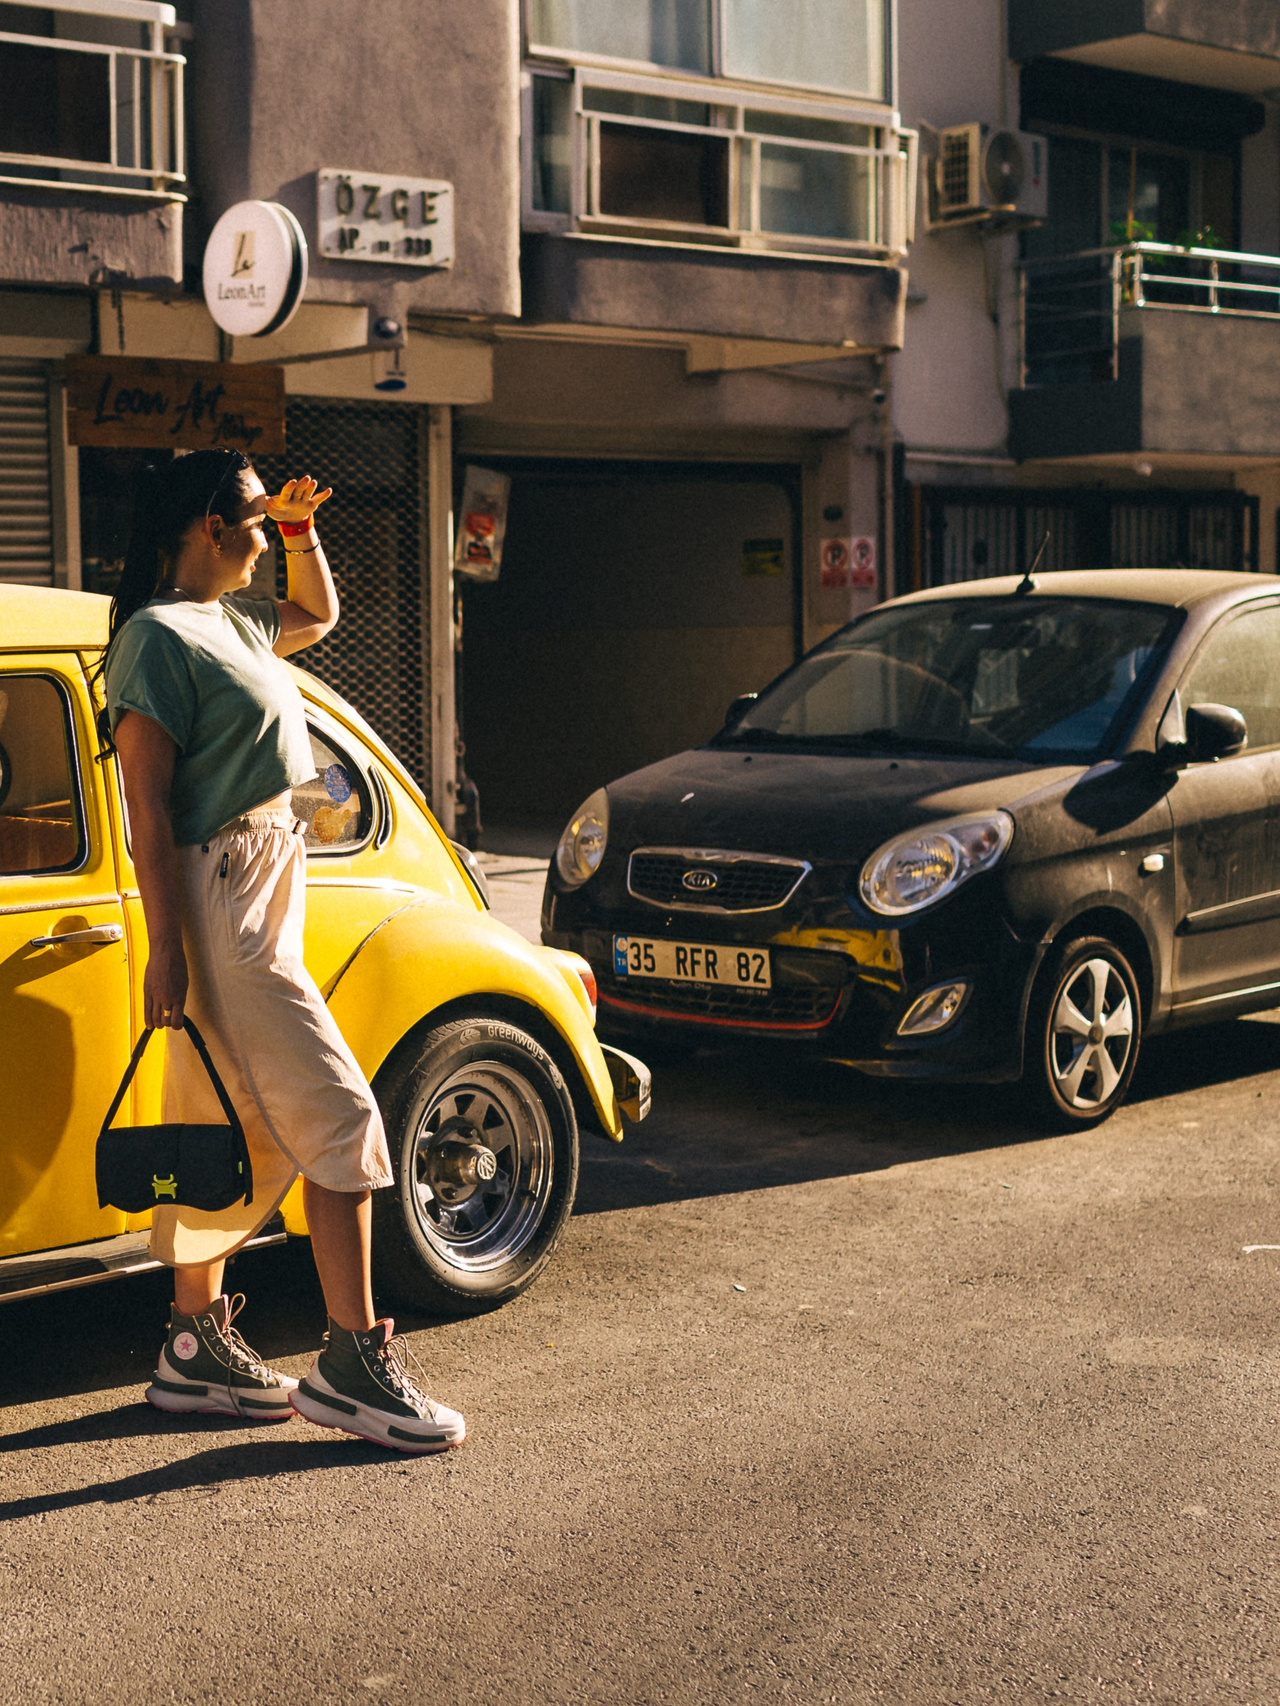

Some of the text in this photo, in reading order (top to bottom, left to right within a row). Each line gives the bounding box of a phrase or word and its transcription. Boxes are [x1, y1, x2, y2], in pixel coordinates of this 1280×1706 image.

[335, 174, 440, 225] ÖZGE
[93, 373, 226, 434] Leon Art
[629, 942, 656, 973] 35
[675, 946, 719, 979] RFR
[736, 952, 767, 984] 82
[487, 1025, 545, 1061] Greenways
